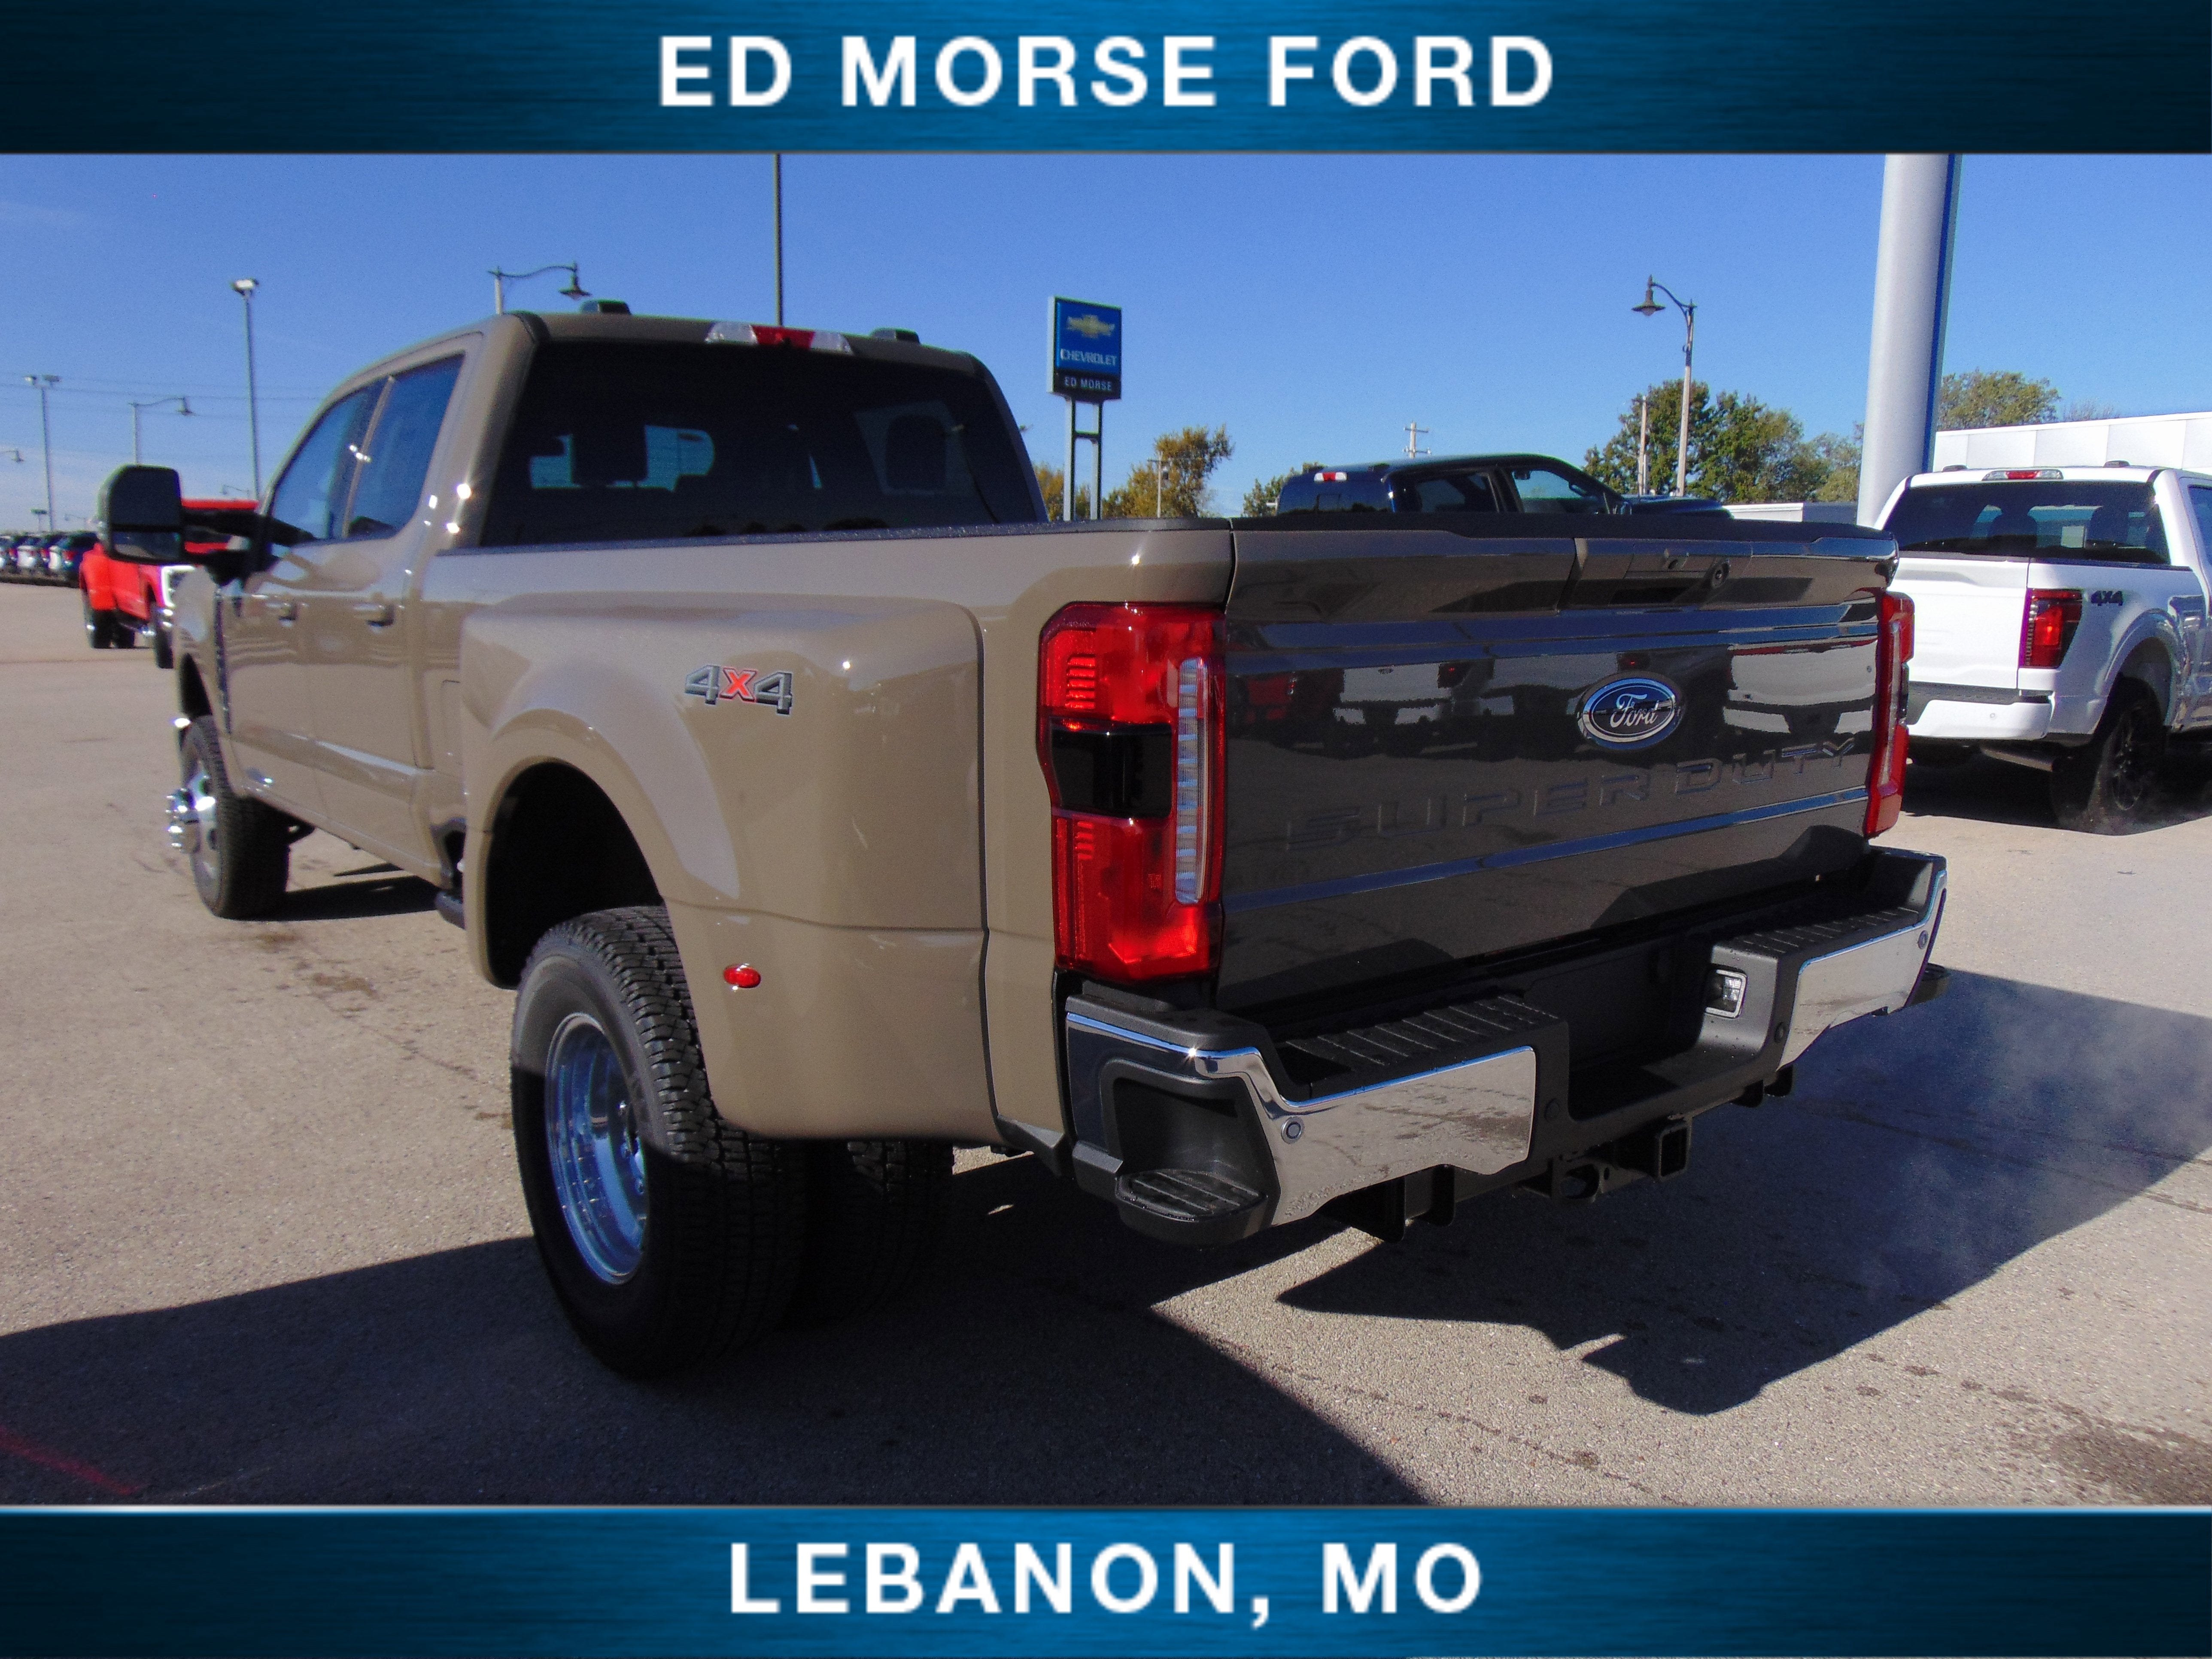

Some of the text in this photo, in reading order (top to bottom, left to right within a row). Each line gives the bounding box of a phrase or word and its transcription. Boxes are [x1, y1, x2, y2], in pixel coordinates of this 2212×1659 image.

[1060, 348, 1117, 366] CHEVROLET
[1064, 377, 1112, 391] ED MORSE
[1610, 693, 1658, 728] Ford
[1286, 737, 1856, 851] SUPER DUTY
